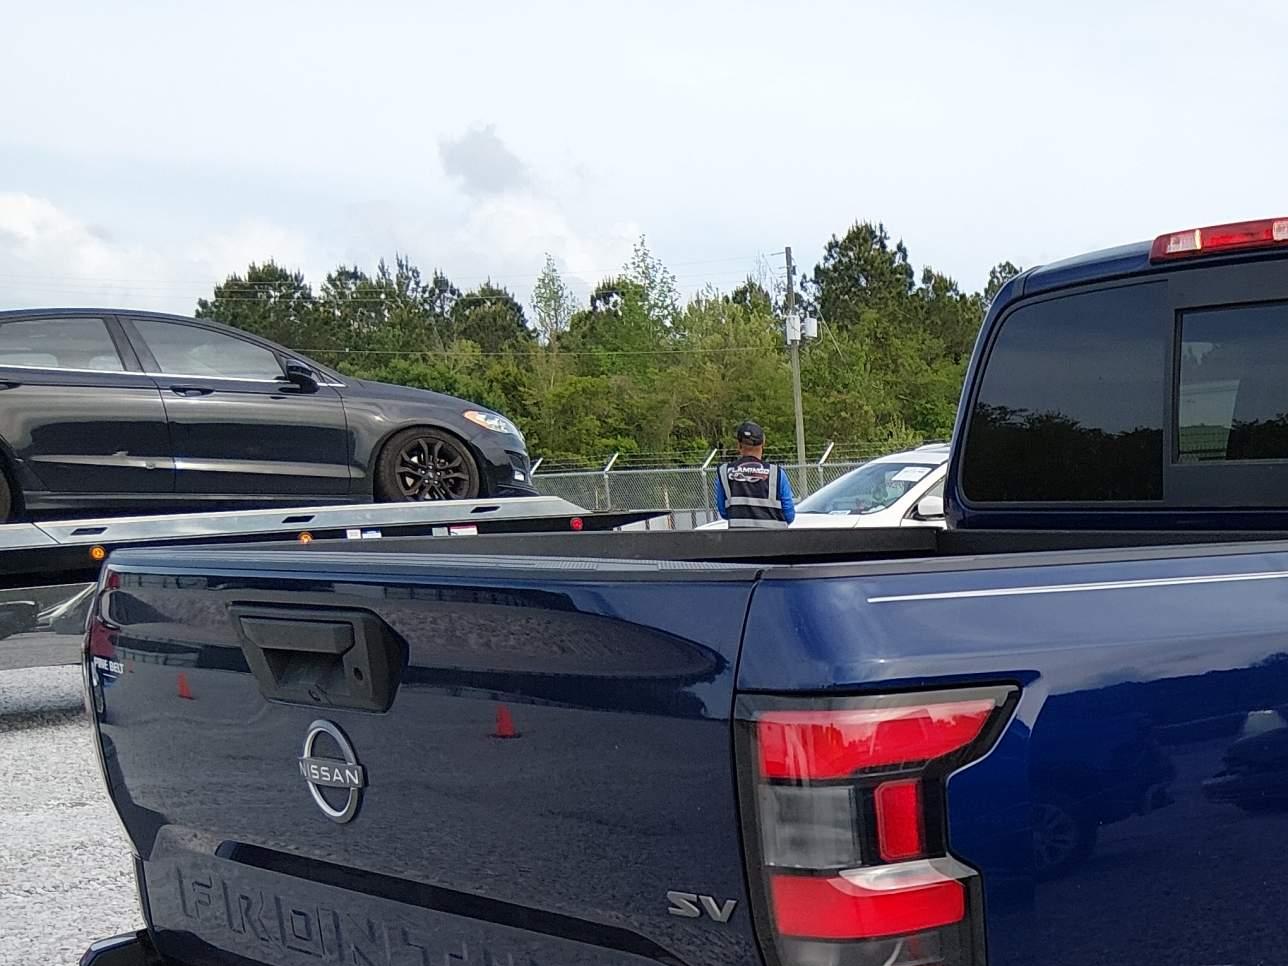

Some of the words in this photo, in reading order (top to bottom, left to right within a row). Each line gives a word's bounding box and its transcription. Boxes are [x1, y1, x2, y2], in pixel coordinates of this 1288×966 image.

[109, 660, 124, 674] BELT
[299, 761, 359, 785] NISSAN
[667, 891, 737, 922] SV
